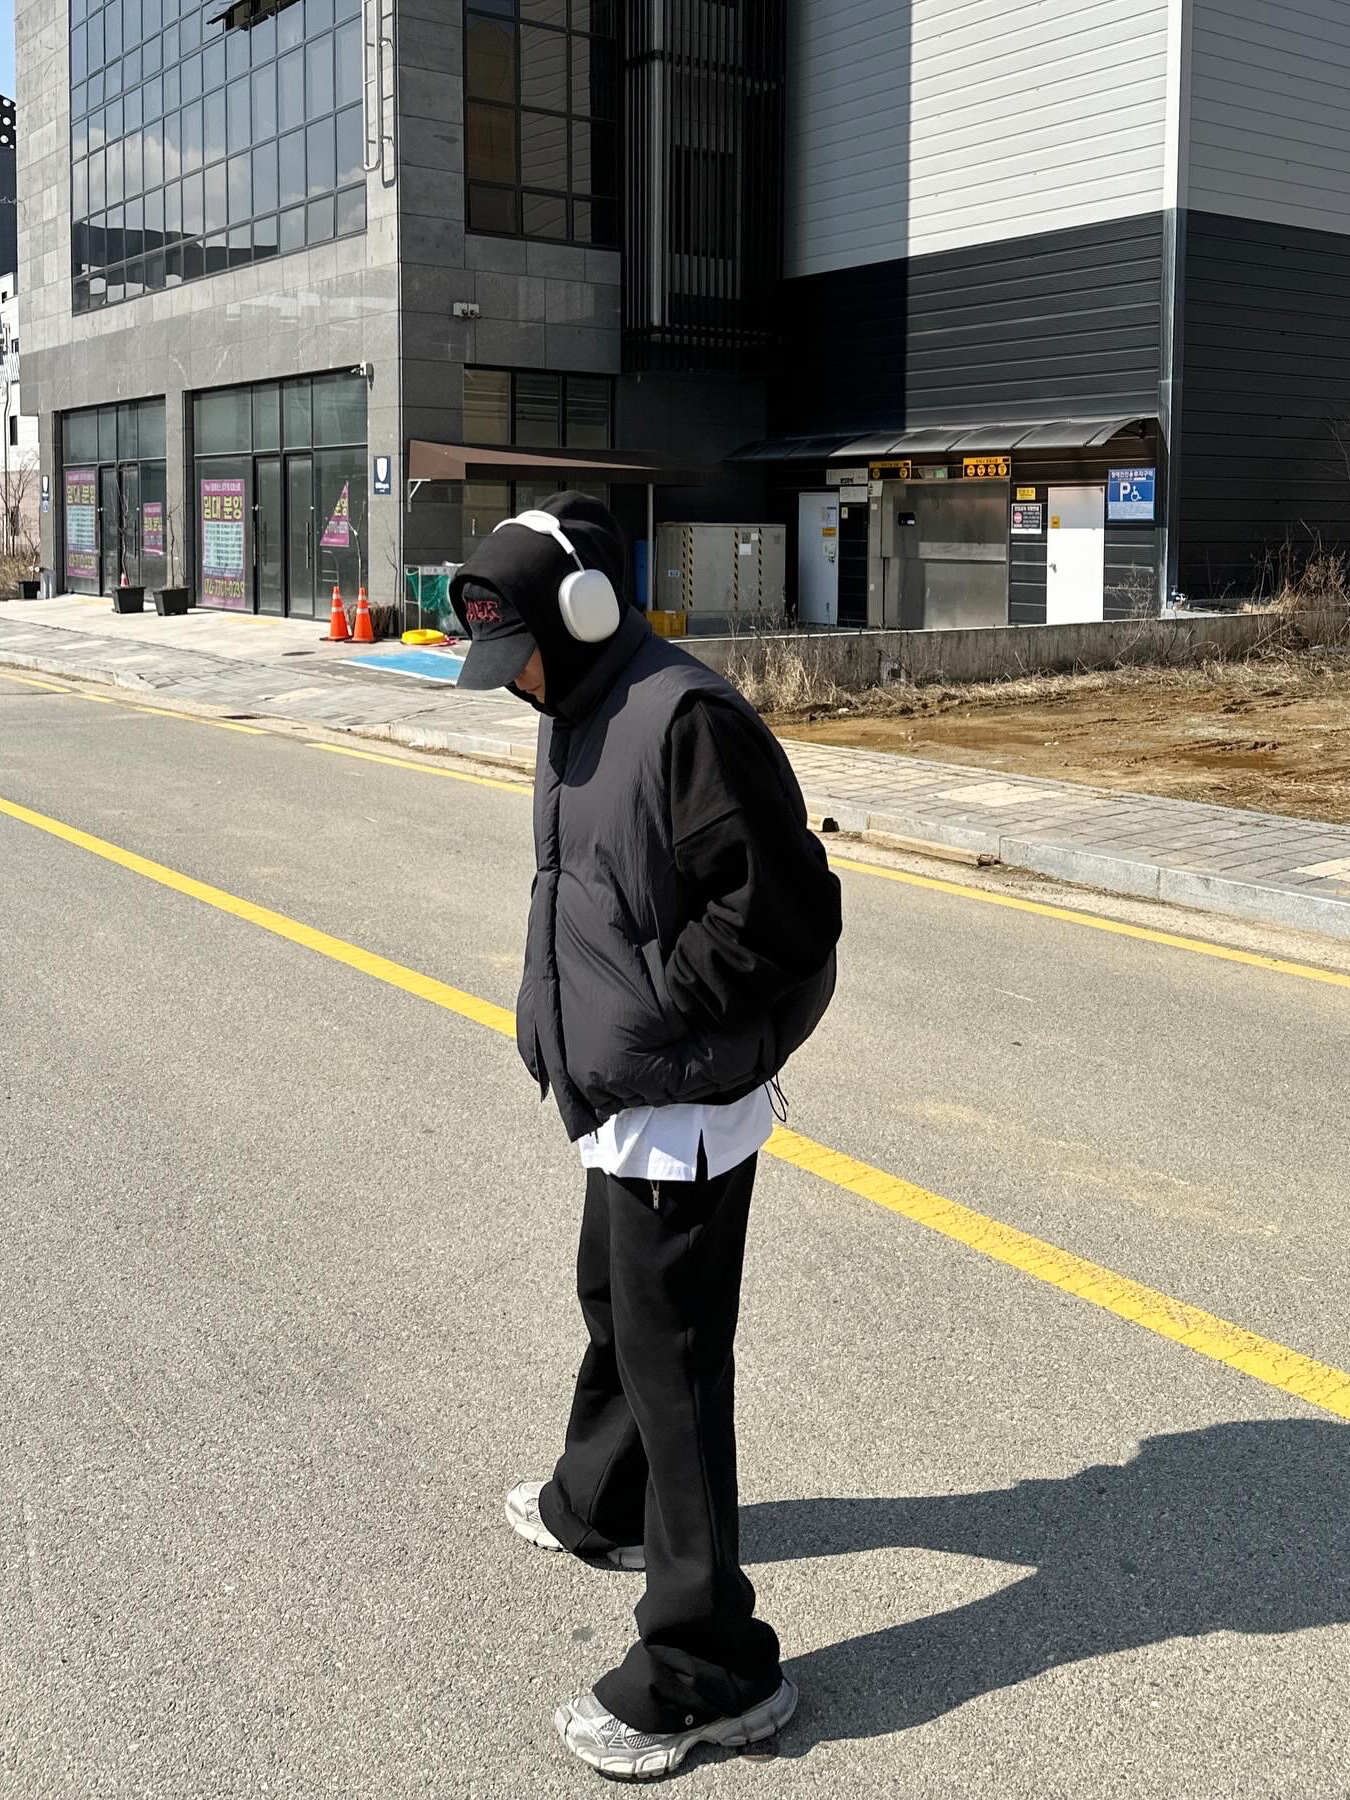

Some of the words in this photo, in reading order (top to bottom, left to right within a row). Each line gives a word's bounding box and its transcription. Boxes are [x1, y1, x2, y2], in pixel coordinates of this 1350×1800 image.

[82, 484, 95, 504] 분양
[1120, 482, 1131, 501] P
[203, 496, 221, 519] 임대
[223, 496, 243, 519] 분양
